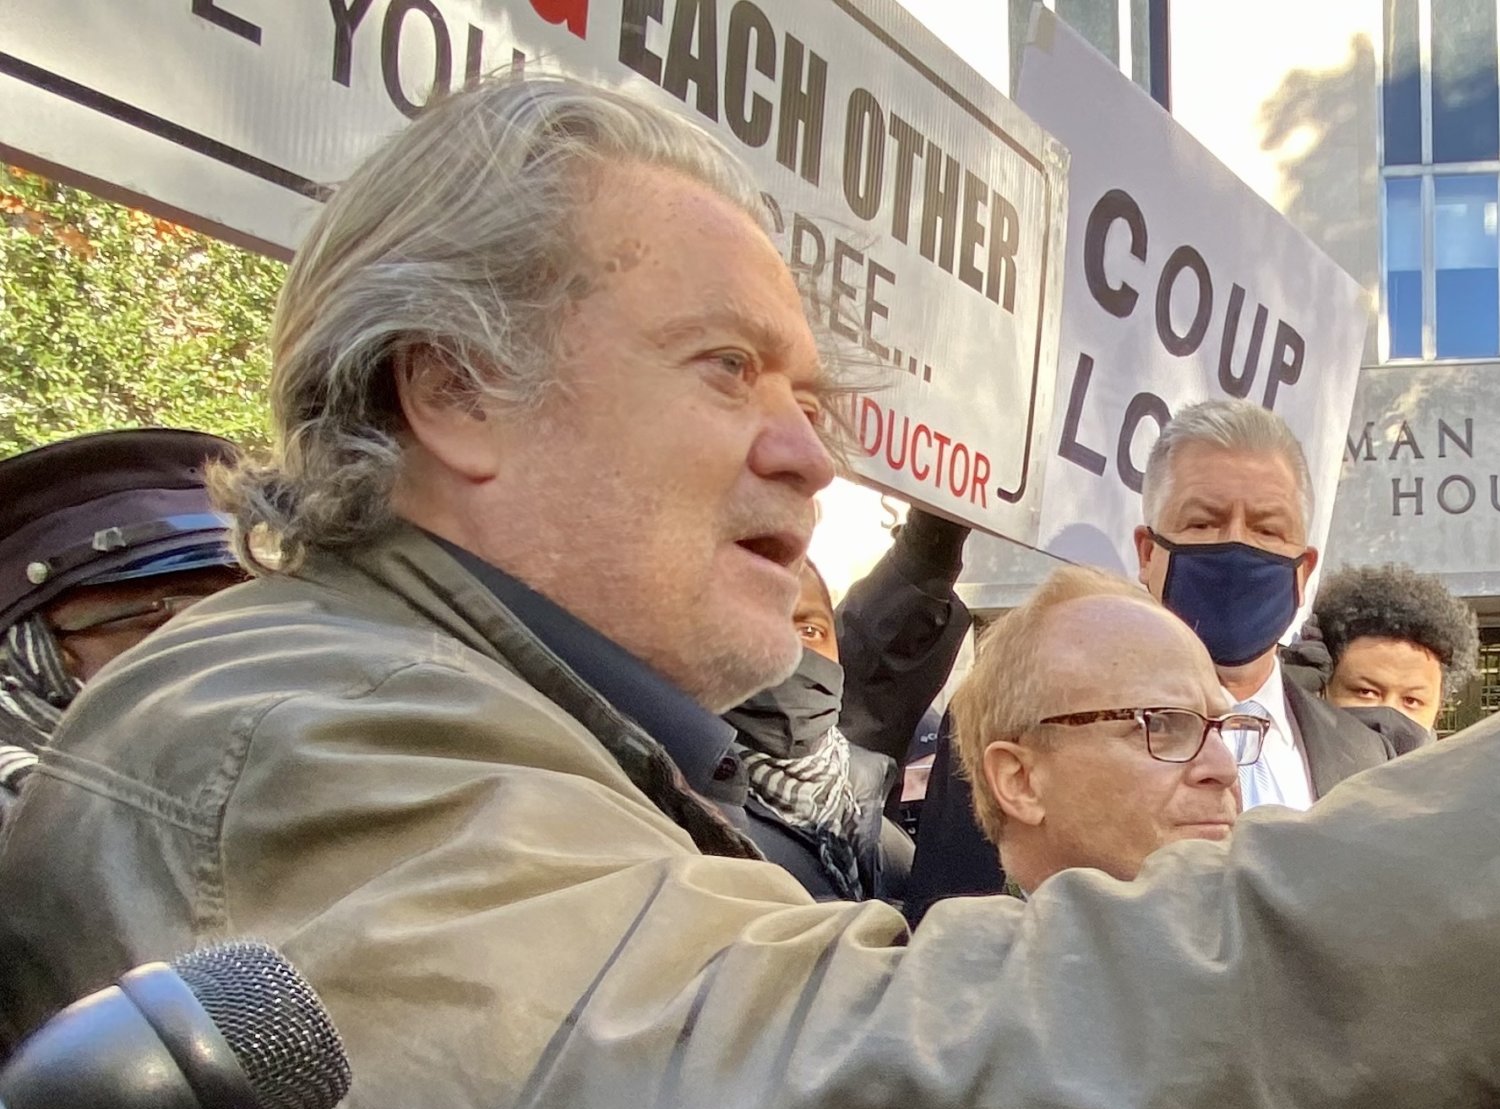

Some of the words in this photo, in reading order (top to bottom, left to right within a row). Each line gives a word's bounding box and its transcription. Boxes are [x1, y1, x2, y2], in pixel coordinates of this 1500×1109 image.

[618, 0, 828, 188] EACH
[842, 87, 1020, 315] OTHER
[1083, 188, 1306, 411] COUP
[1057, 352, 1172, 495] LO
[1343, 417, 1474, 463] MAN
